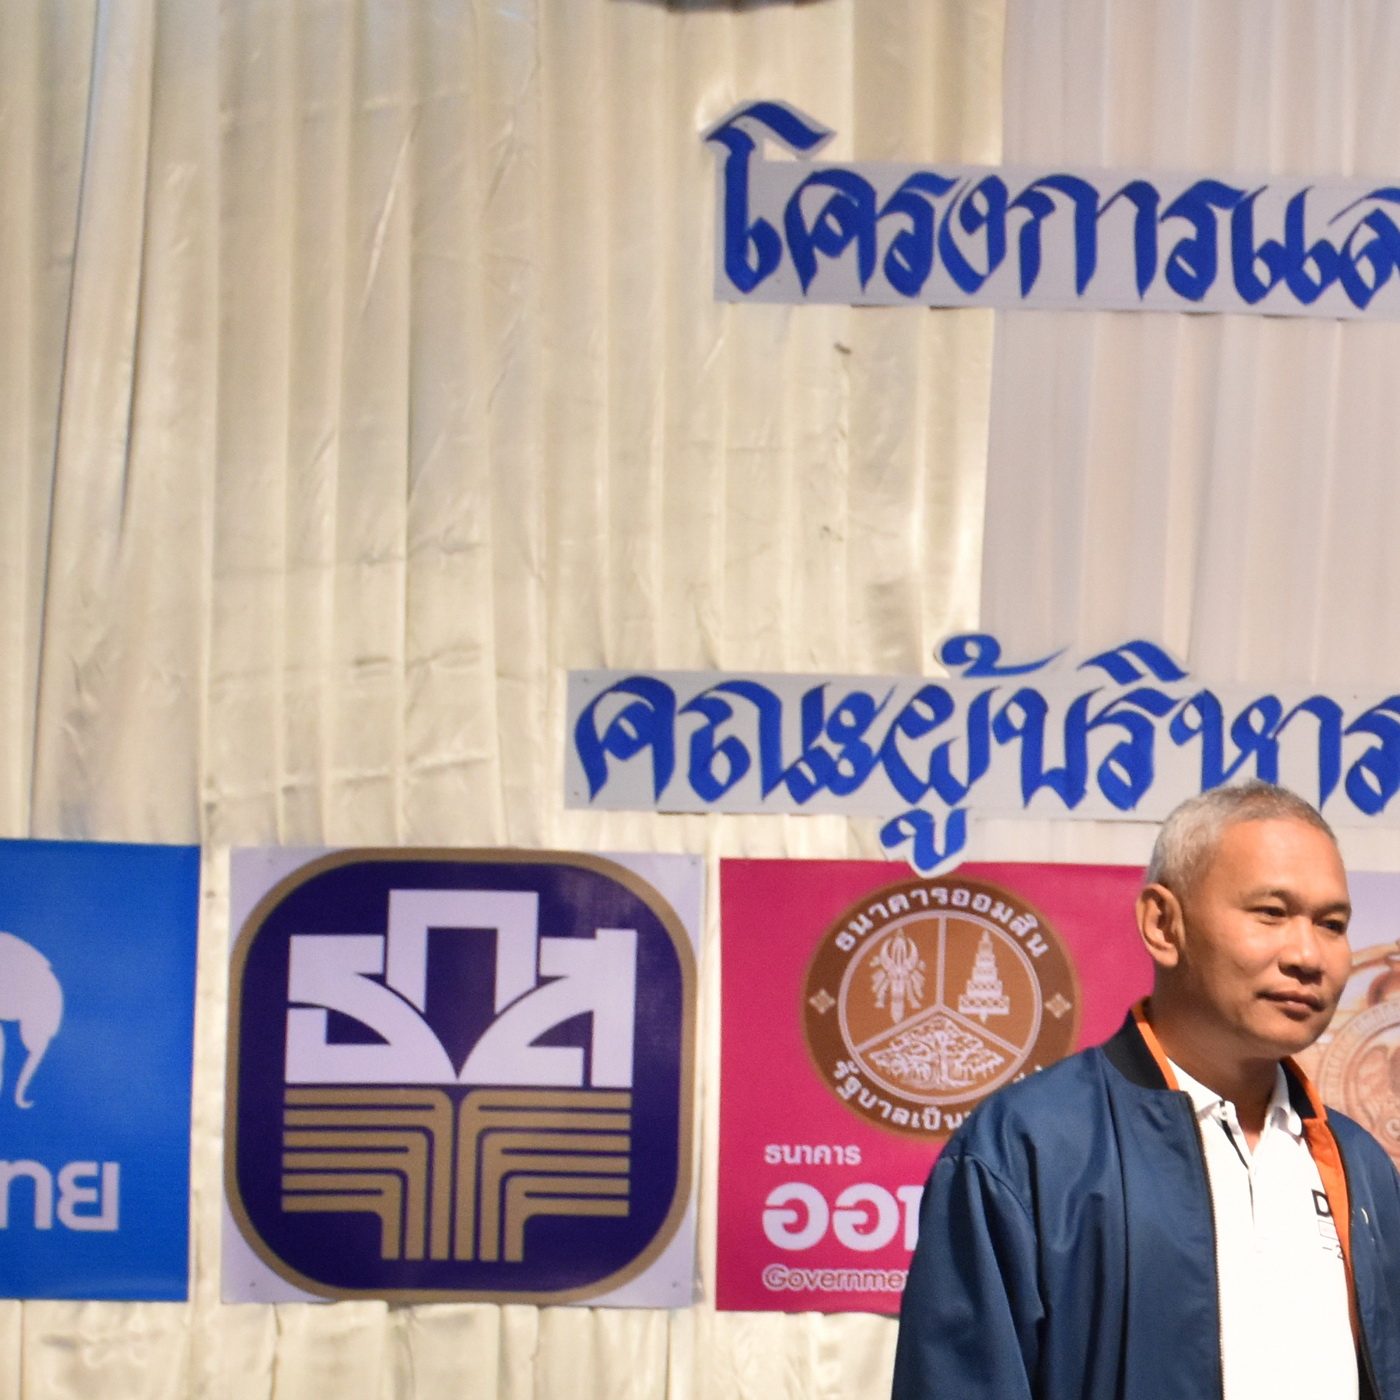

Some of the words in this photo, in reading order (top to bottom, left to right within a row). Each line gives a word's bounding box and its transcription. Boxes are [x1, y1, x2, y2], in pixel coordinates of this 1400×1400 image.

[833, 884, 1050, 960] ธนาคารออมสิน
[764, 1142, 862, 1166] ธนาคาร
[762, 1263, 909, 1292] Governme
